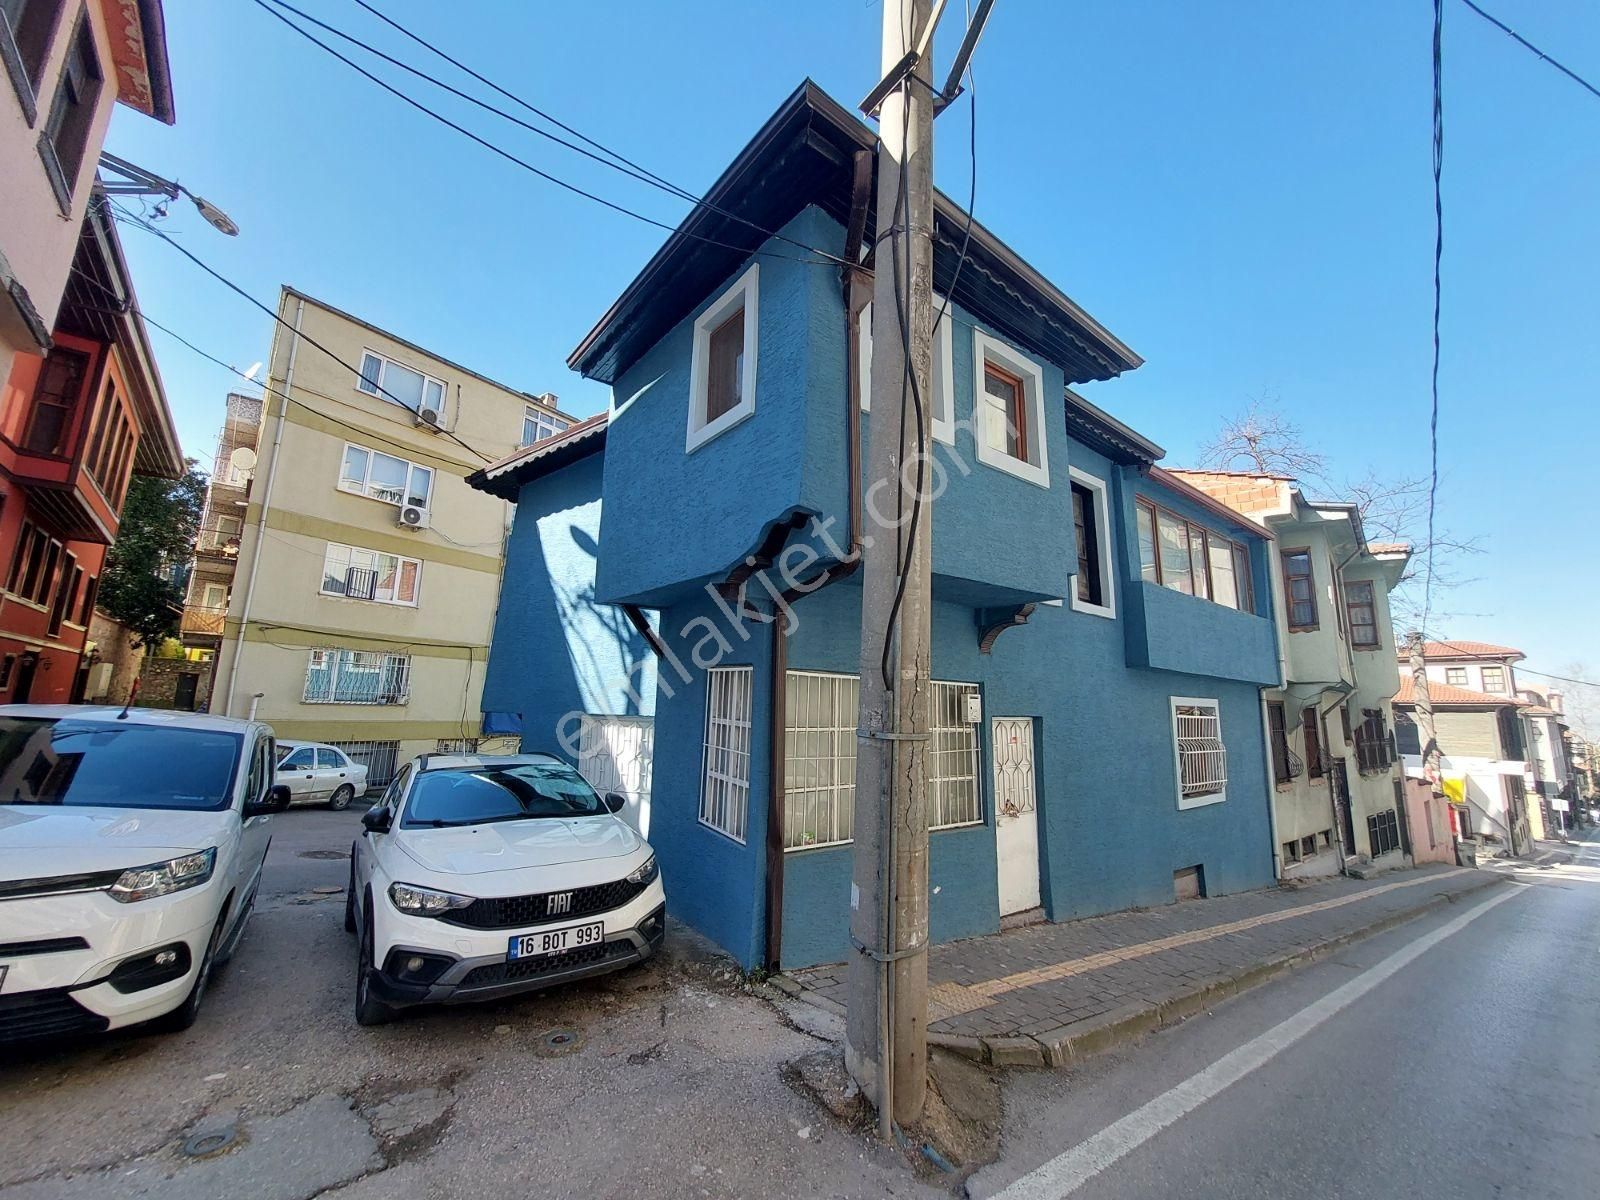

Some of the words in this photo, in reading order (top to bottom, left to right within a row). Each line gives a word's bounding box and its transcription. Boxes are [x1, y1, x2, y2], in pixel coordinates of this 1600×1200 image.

[546, 892, 574, 915] FIAT
[519, 937, 535, 955] 16
[542, 931, 568, 952] BOT
[577, 925, 601, 945] 993
